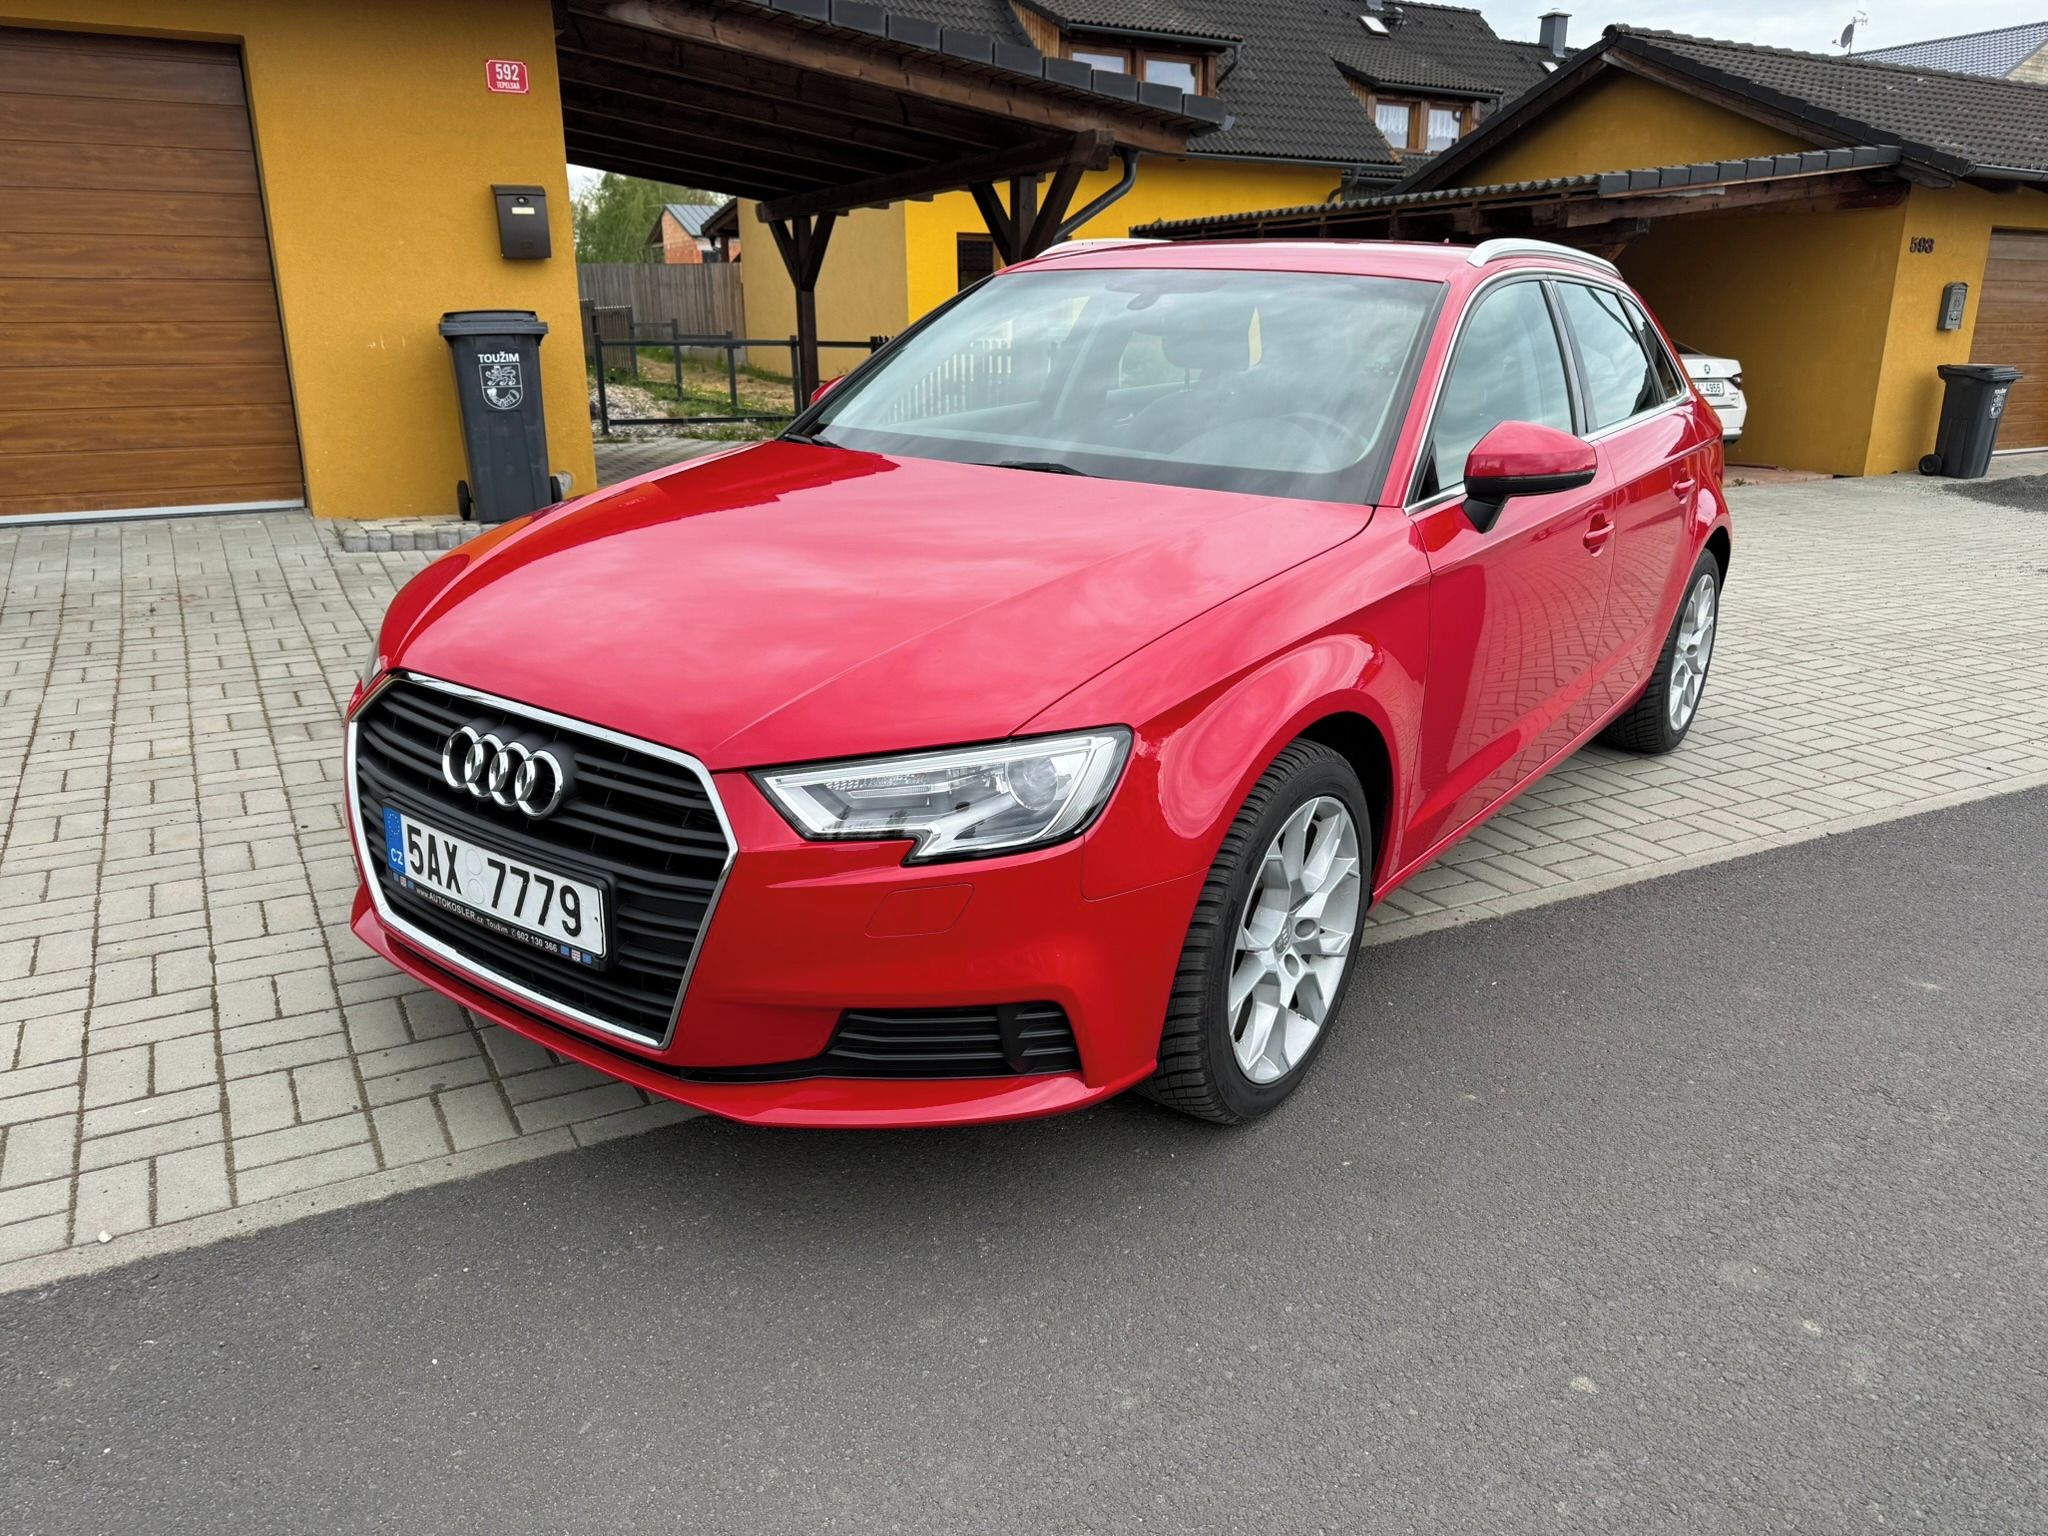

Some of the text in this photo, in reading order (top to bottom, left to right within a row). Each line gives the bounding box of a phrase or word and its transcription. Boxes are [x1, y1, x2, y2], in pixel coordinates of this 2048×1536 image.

[495, 63, 520, 81] 592
[478, 351, 520, 363] TOUŽIM
[390, 824, 582, 938] CZ 5AX 7779
[516, 930, 530, 943] 602
[531, 935, 543, 948] 130
